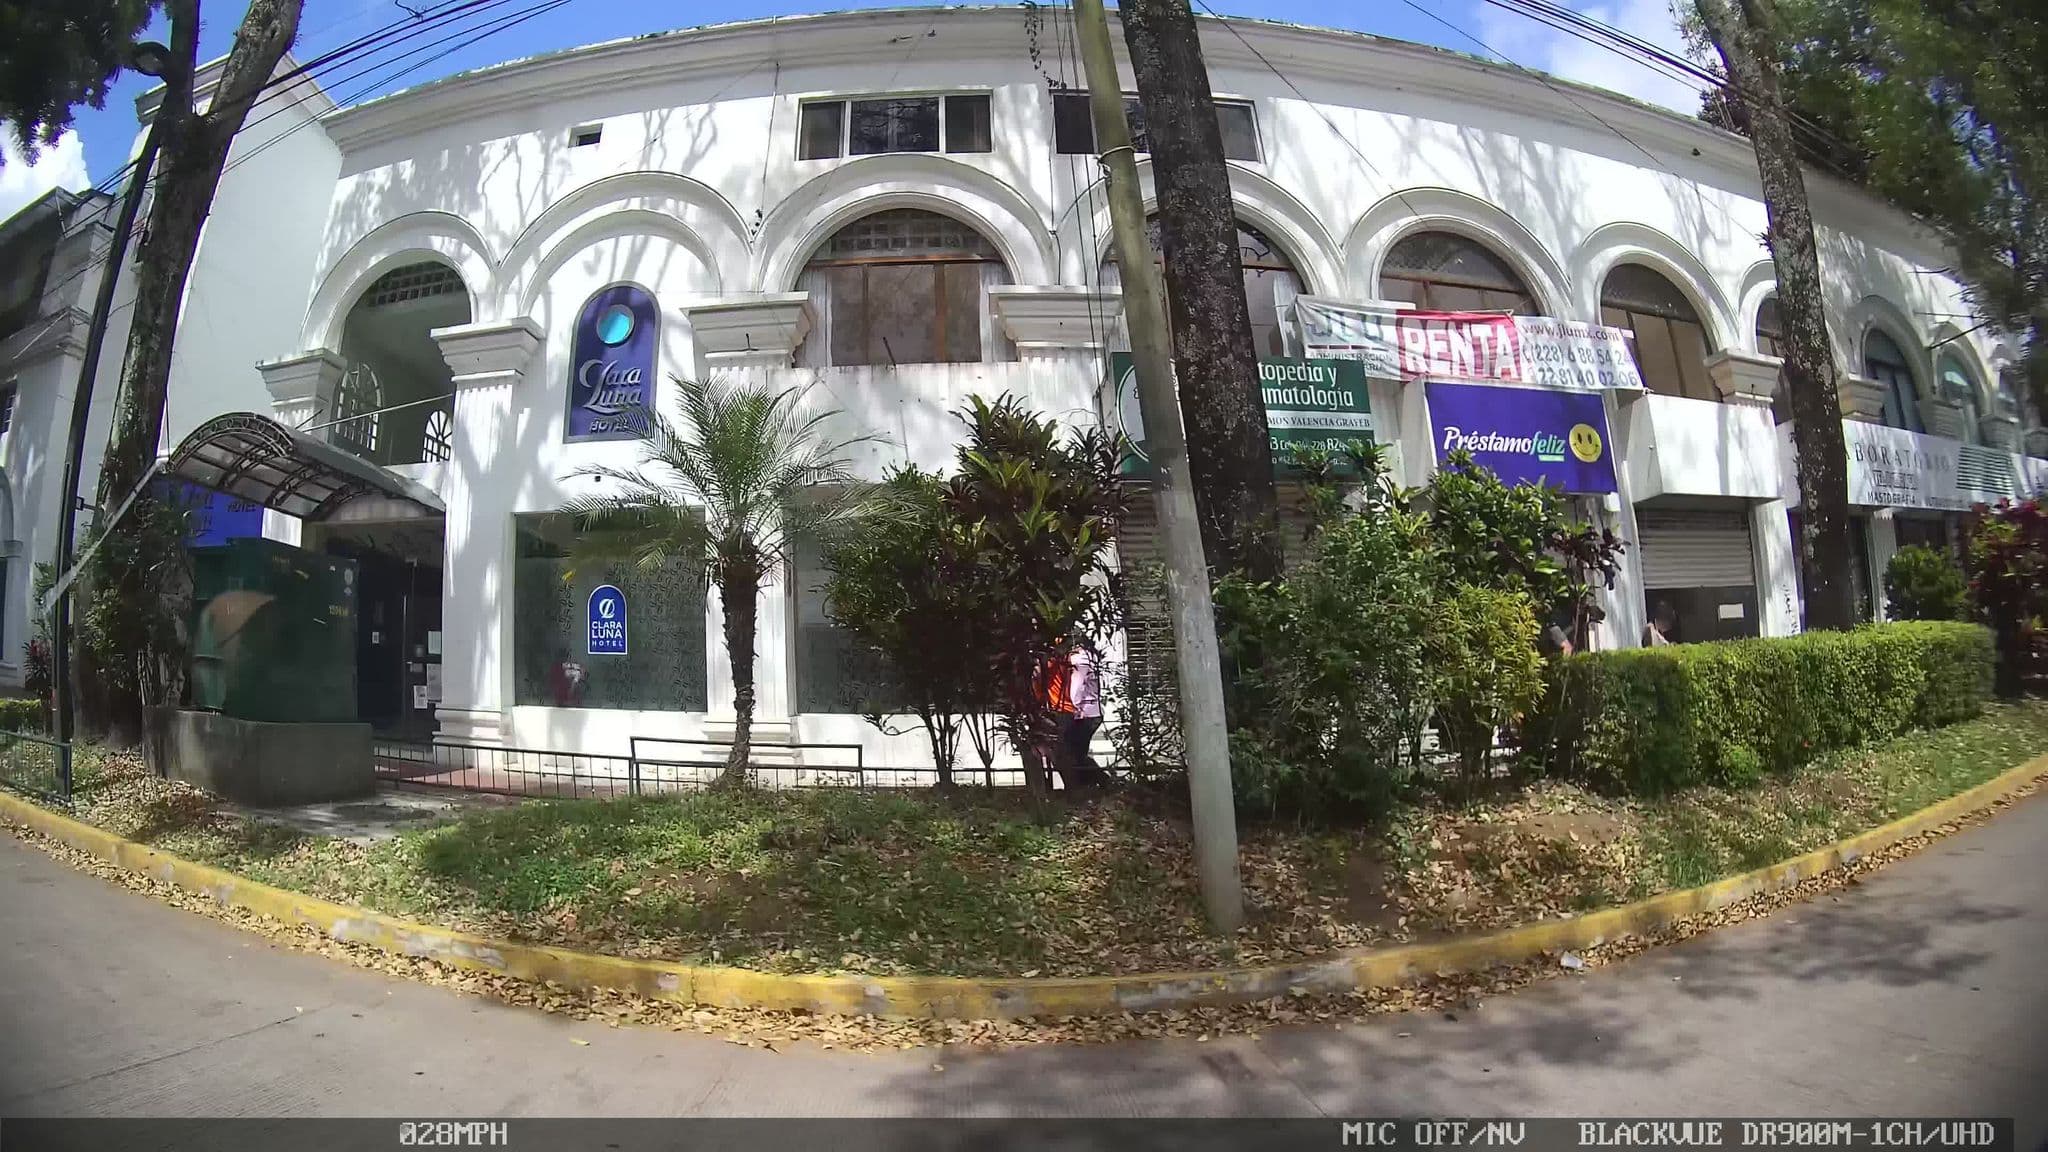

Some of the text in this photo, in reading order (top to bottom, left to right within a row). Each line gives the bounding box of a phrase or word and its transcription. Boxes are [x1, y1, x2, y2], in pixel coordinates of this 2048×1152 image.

[1401, 318, 1521, 378] RENTA
[1531, 343, 1564, 365] (228)
[1567, 344, 1576, 362] 6
[1596, 348, 1613, 366] 54
[579, 359, 641, 388] Clara
[1257, 361, 1337, 388] topedia y
[583, 388, 641, 415] Luna
[592, 621, 622, 629] CLARA
[592, 629, 623, 639] LUNA
